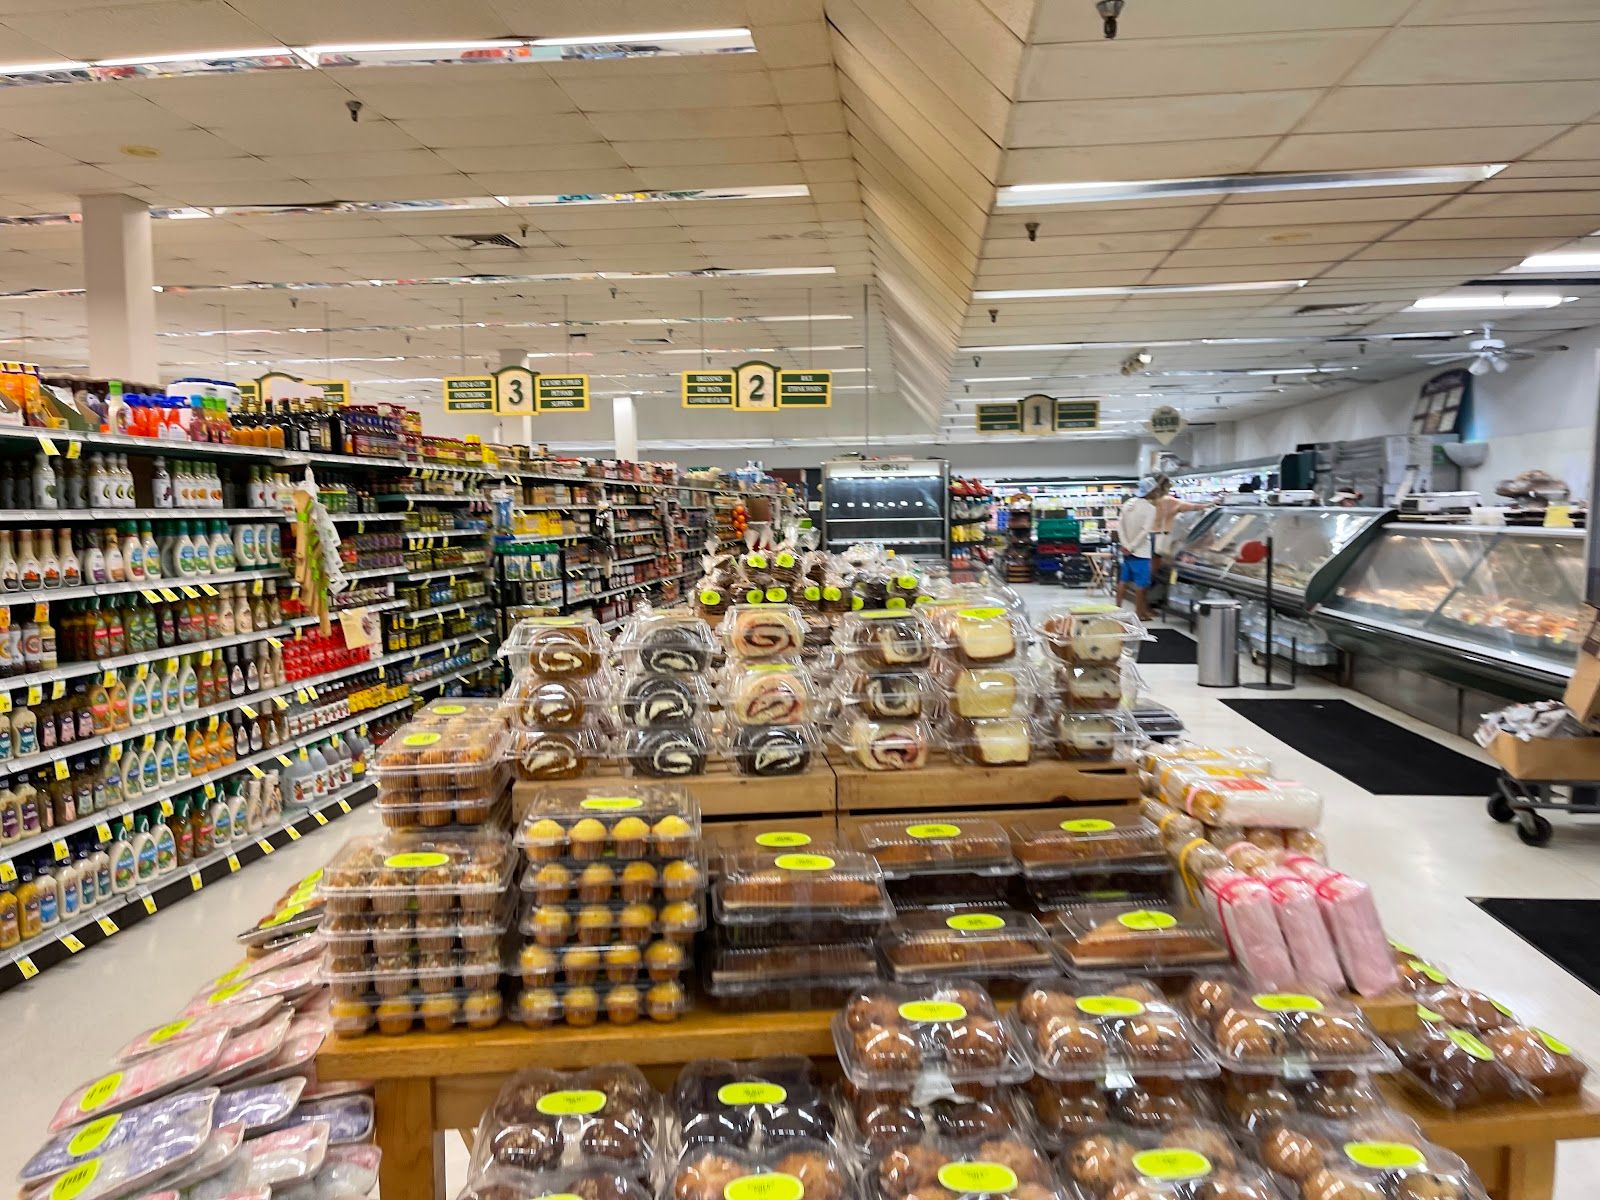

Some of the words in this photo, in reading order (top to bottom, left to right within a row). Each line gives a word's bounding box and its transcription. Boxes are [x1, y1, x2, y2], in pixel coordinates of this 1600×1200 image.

[508, 379, 524, 405] 3
[749, 374, 764, 401] 2
[1032, 405, 1043, 425] 1
